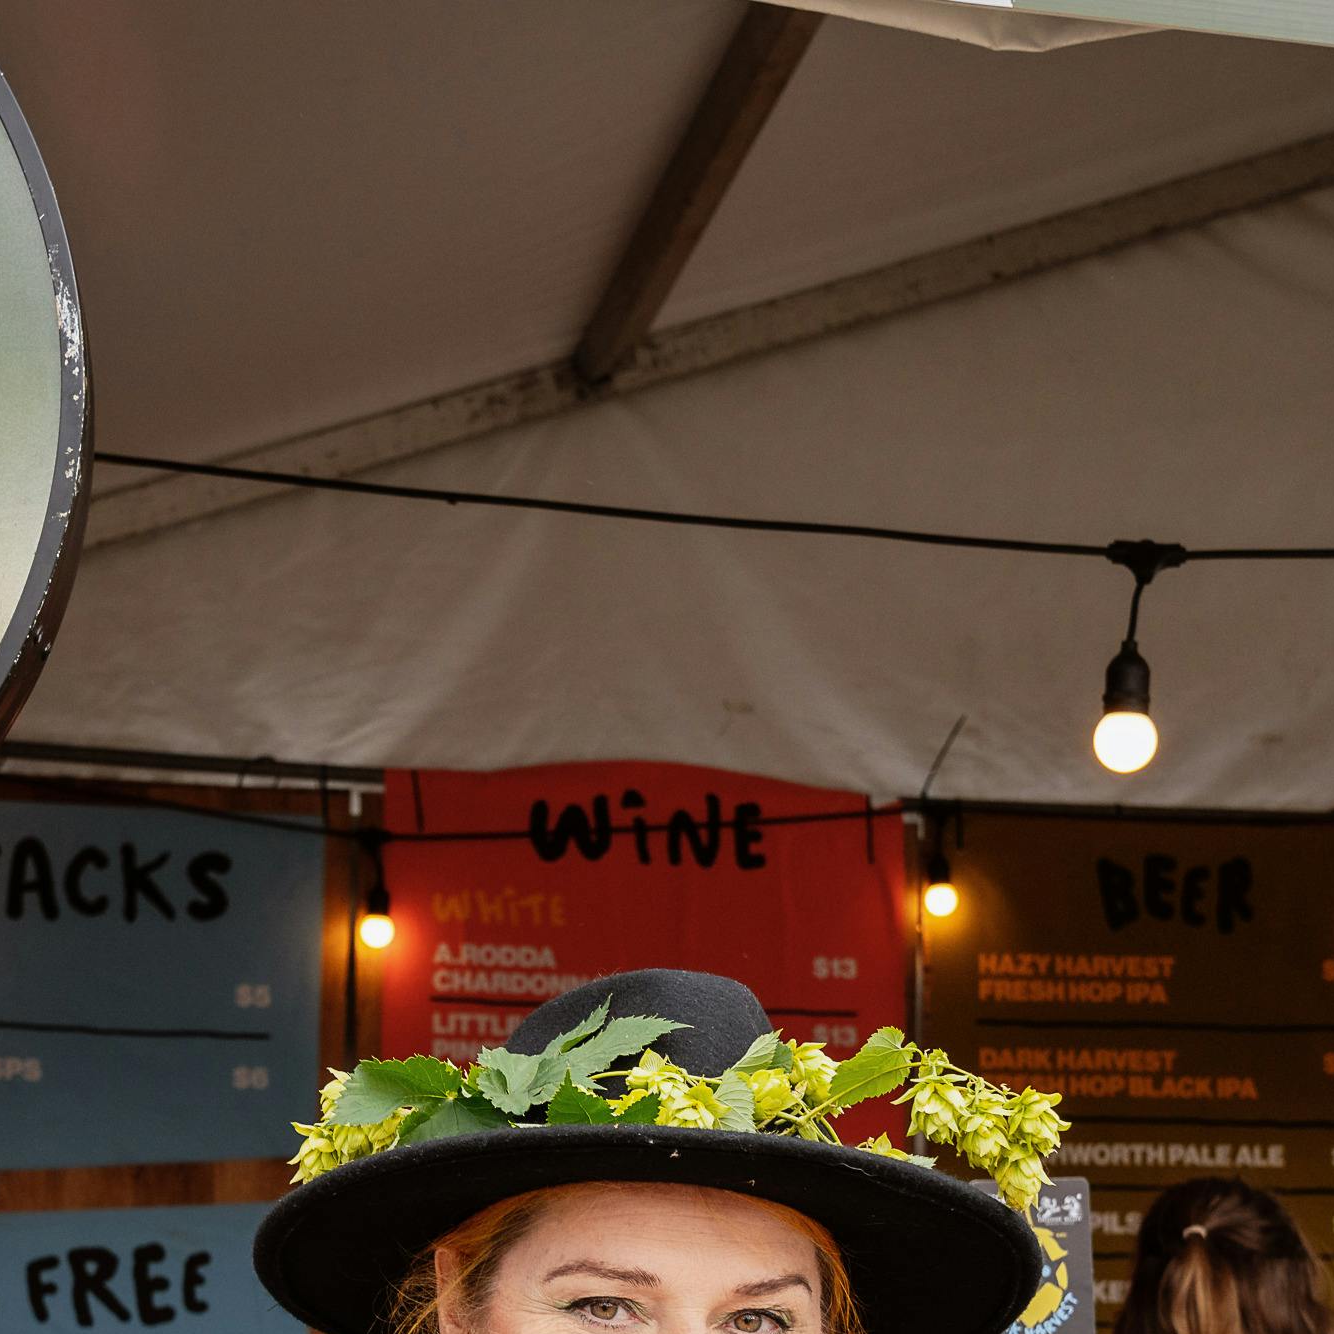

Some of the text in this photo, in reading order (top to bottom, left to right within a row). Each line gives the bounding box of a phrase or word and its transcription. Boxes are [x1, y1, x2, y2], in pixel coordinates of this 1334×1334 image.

[1096, 853, 1254, 935] BEER
[813, 957, 857, 980] $13
[978, 953, 1174, 979] HAZY HARVEST
[978, 979, 1168, 1004] FRESH HOP IPA
[813, 1025, 857, 1048] $13
[979, 1047, 1178, 1073] DARK HARVEST
[1070, 1075, 1125, 1098] HOP
[1128, 1076, 1212, 1099] BLACK
[1216, 1078, 1259, 1100] IPA
[1171, 1144, 1232, 1168] PALE
[1235, 1145, 1285, 1168] ALE
[25, 1242, 212, 1327] FREE
